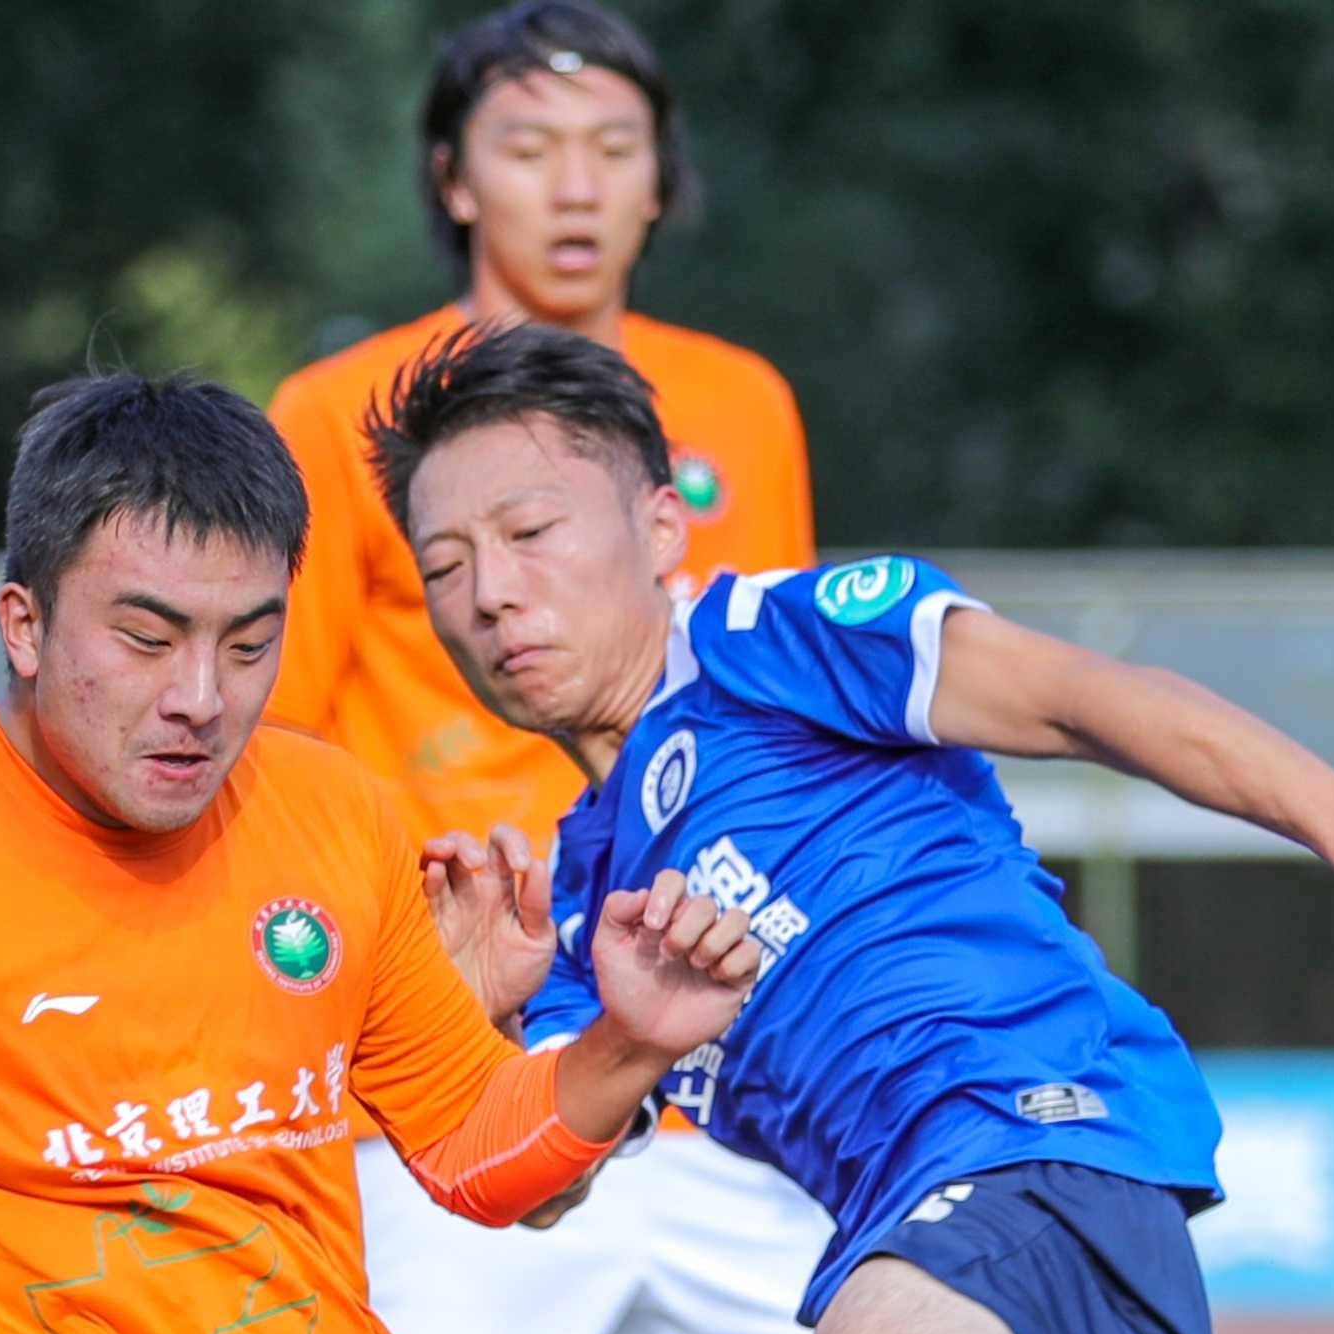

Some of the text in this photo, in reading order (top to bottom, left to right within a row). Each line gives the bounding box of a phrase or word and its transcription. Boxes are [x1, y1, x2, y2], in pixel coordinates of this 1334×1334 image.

[42, 1041, 347, 1169] 北京理工大学
